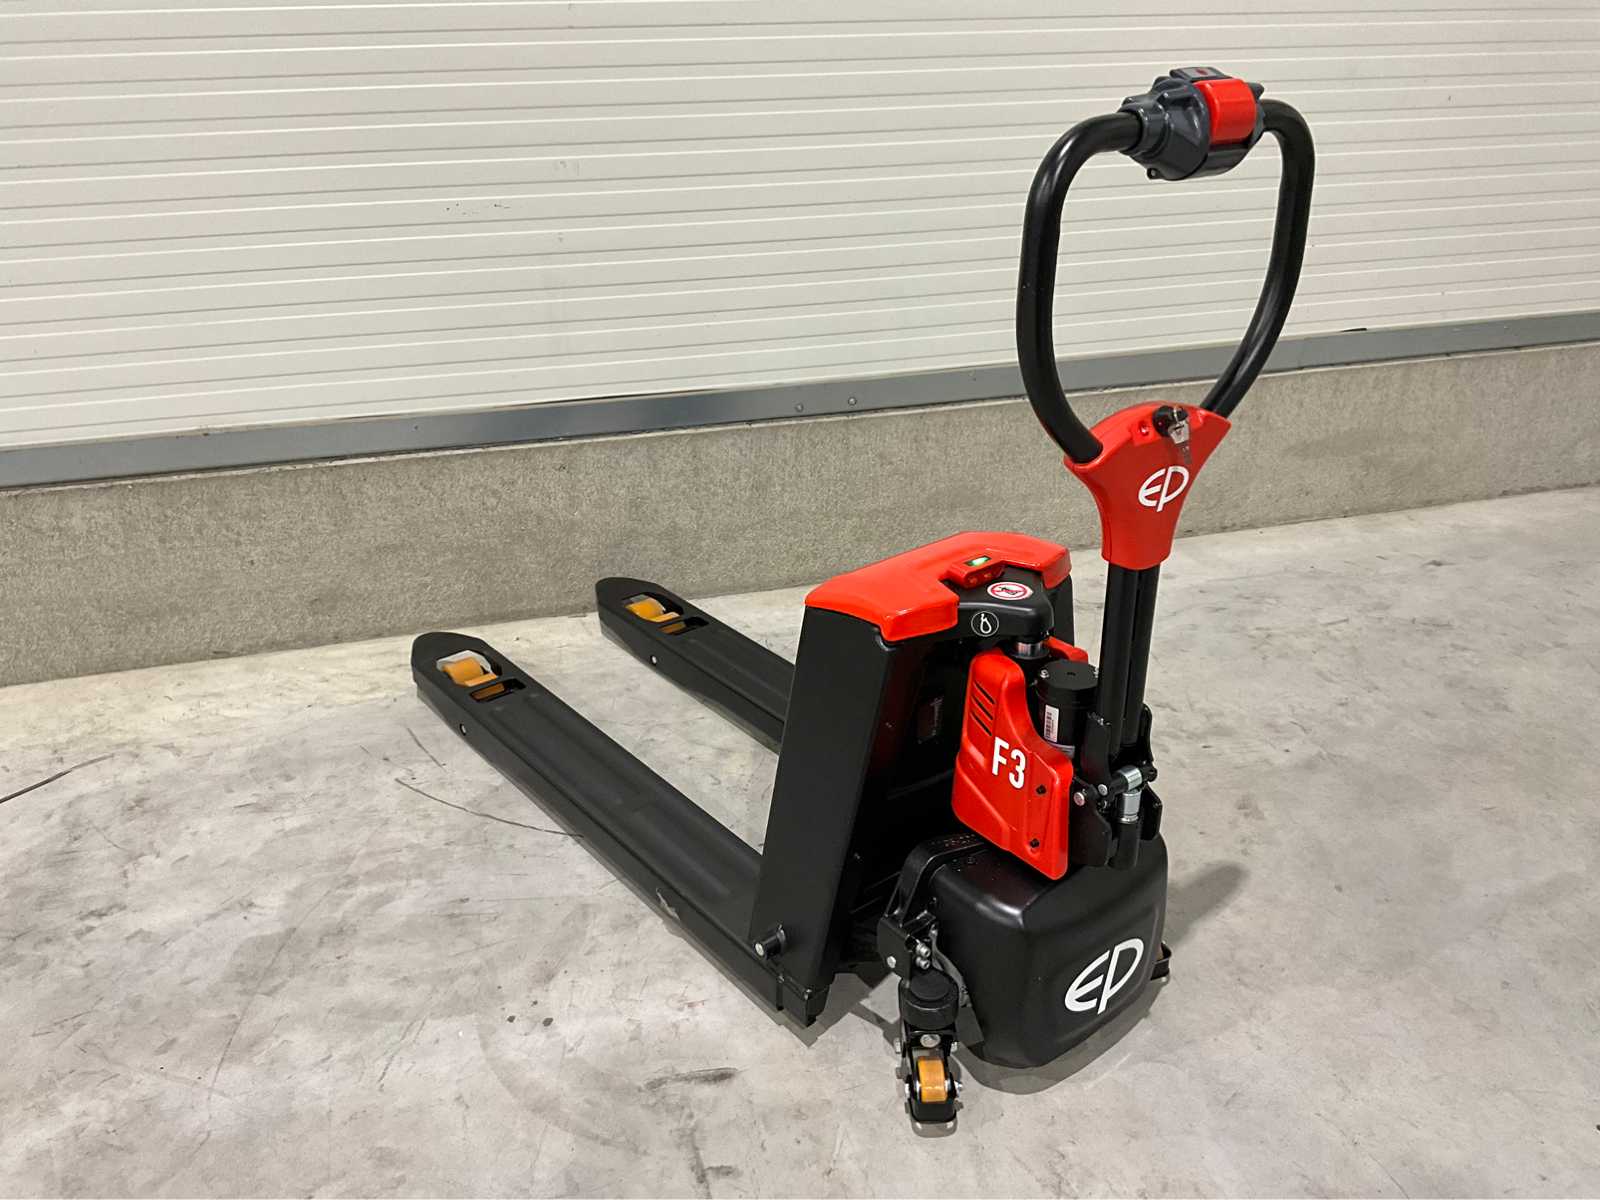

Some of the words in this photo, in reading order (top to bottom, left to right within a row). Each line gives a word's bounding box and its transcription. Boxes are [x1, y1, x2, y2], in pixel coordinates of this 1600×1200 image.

[1138, 466, 1189, 512] EP
[992, 736, 1026, 789] F3
[1065, 938, 1144, 1014] EP
